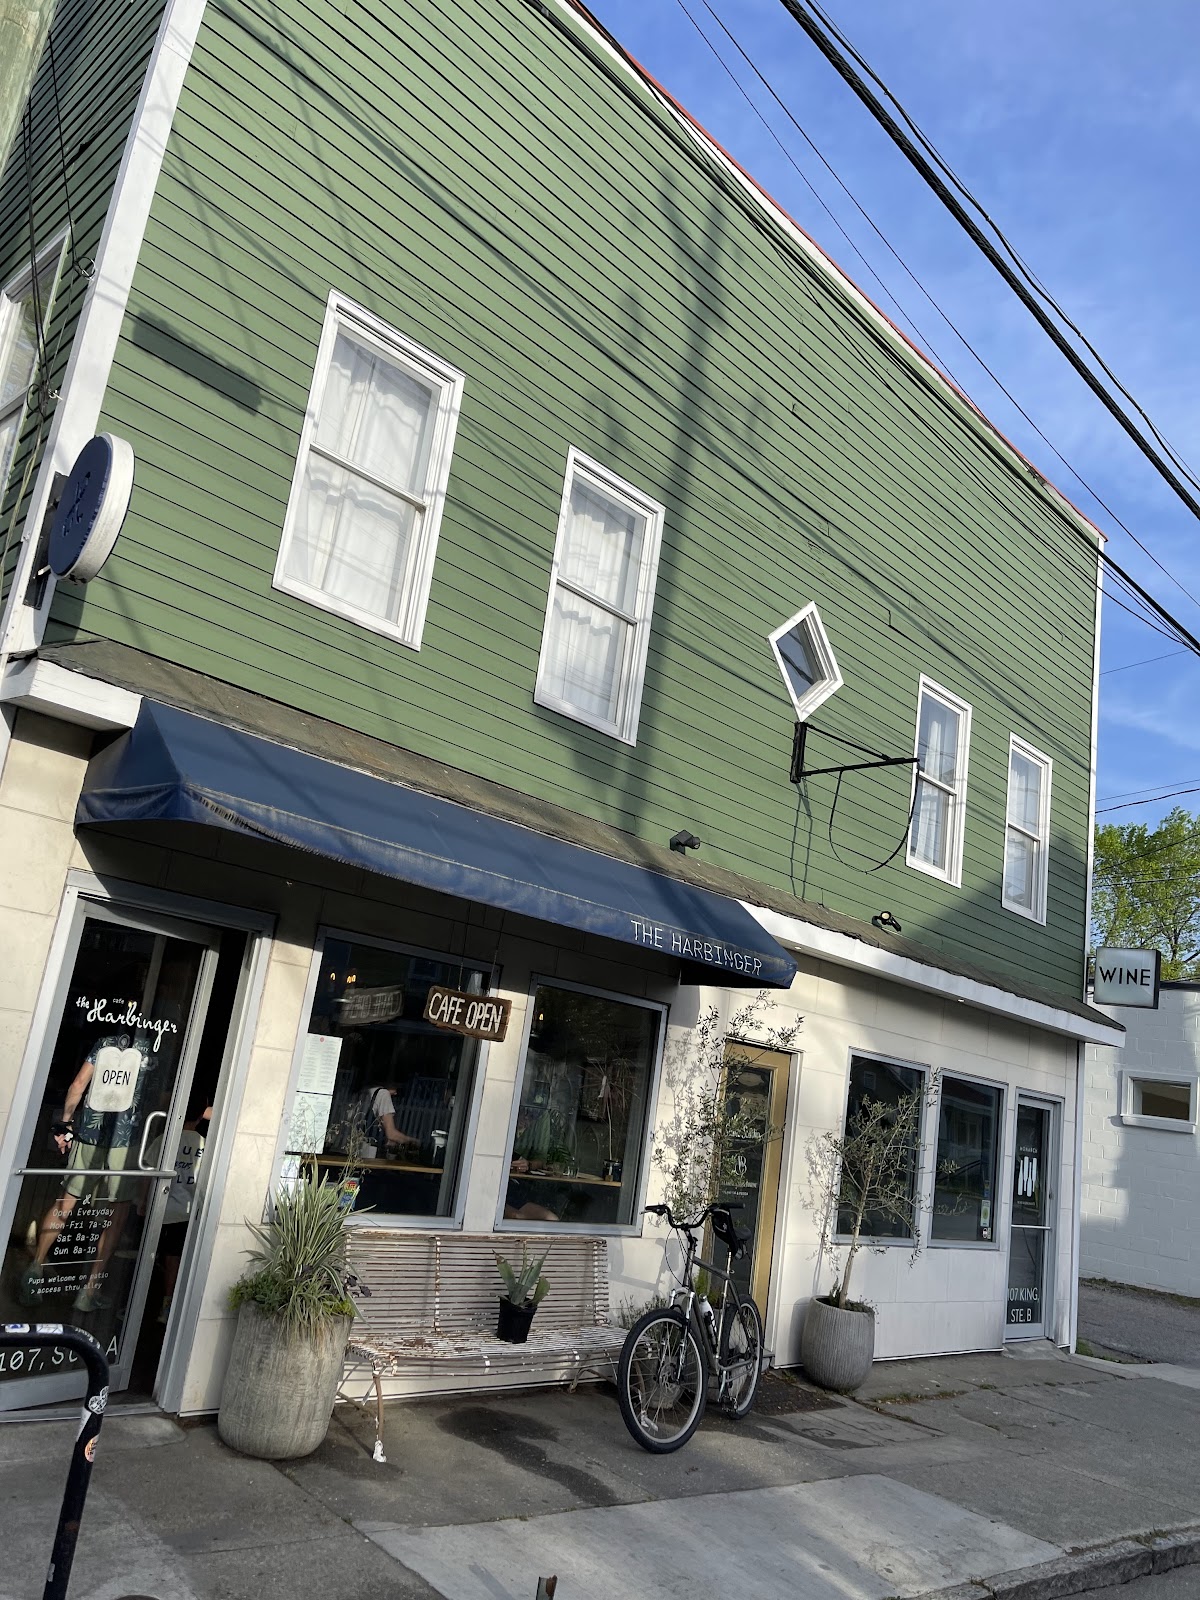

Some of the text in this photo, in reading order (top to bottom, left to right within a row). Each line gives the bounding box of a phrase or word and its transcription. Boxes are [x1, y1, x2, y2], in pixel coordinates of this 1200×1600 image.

[630, 920, 762, 976] THE HARBINGER
[1099, 966, 1150, 986] WINE
[76, 996, 89, 1009] the
[428, 993, 503, 1033] CAFE OPEN
[87, 998, 177, 1052] Harbinger
[102, 1069, 131, 1085] OPEN
[53, 1208, 115, 1217] Open Everyday
[49, 1220, 112, 1229] Mon-Fri 7a-3p
[57, 1233, 100, 1242] Sat 8a-3p
[54, 1246, 97, 1255] Sun 8a-1p
[28, 1277, 45, 1285] Pups
[48, 1275, 76, 1283] welcome
[90, 1272, 109, 1280] patio
[37, 1286, 61, 1294] access
[83, 1282, 102, 1290] alley
[1027, 1308, 1032, 1322] B
[106, 1335, 118, 1356] A
